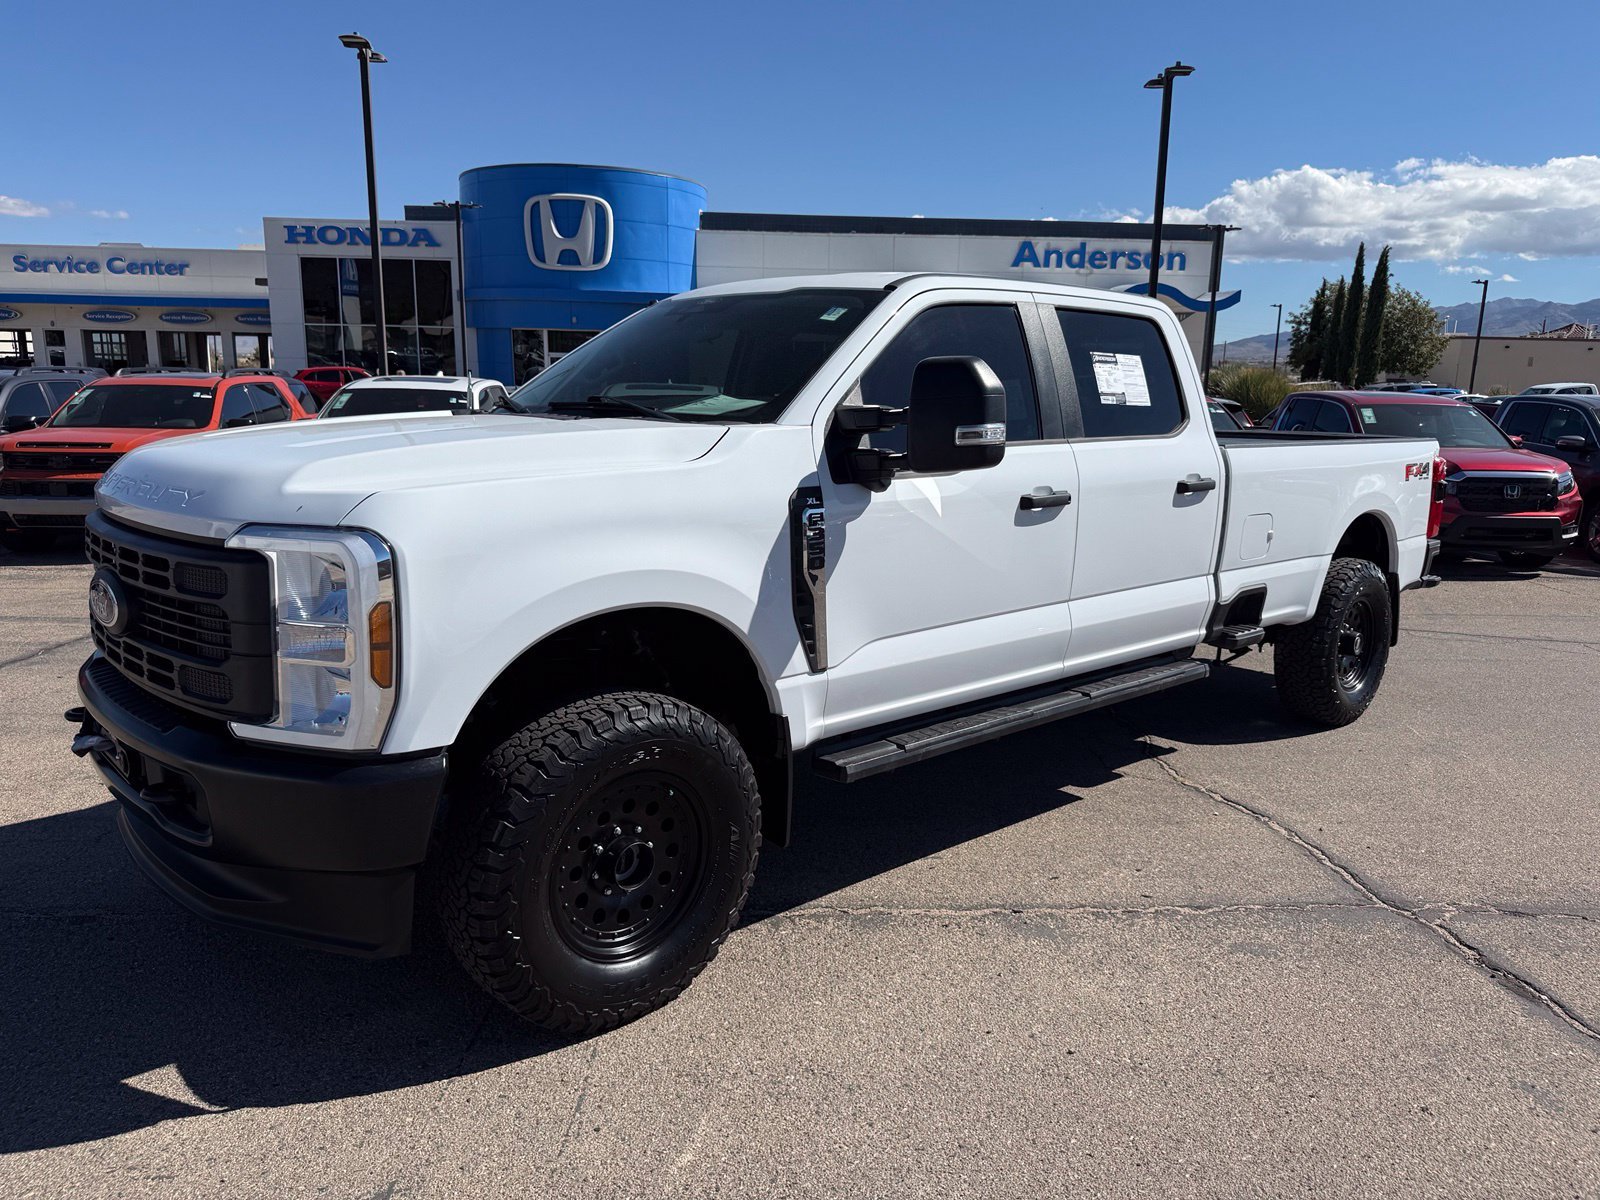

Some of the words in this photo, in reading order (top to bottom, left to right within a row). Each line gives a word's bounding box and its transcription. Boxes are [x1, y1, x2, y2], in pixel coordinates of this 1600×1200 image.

[283, 225, 442, 248] HONDA
[13, 254, 100, 274] Service
[106, 256, 190, 276] Center
[1011, 241, 1186, 271] Anderson
[1405, 462, 1430, 481] FX4
